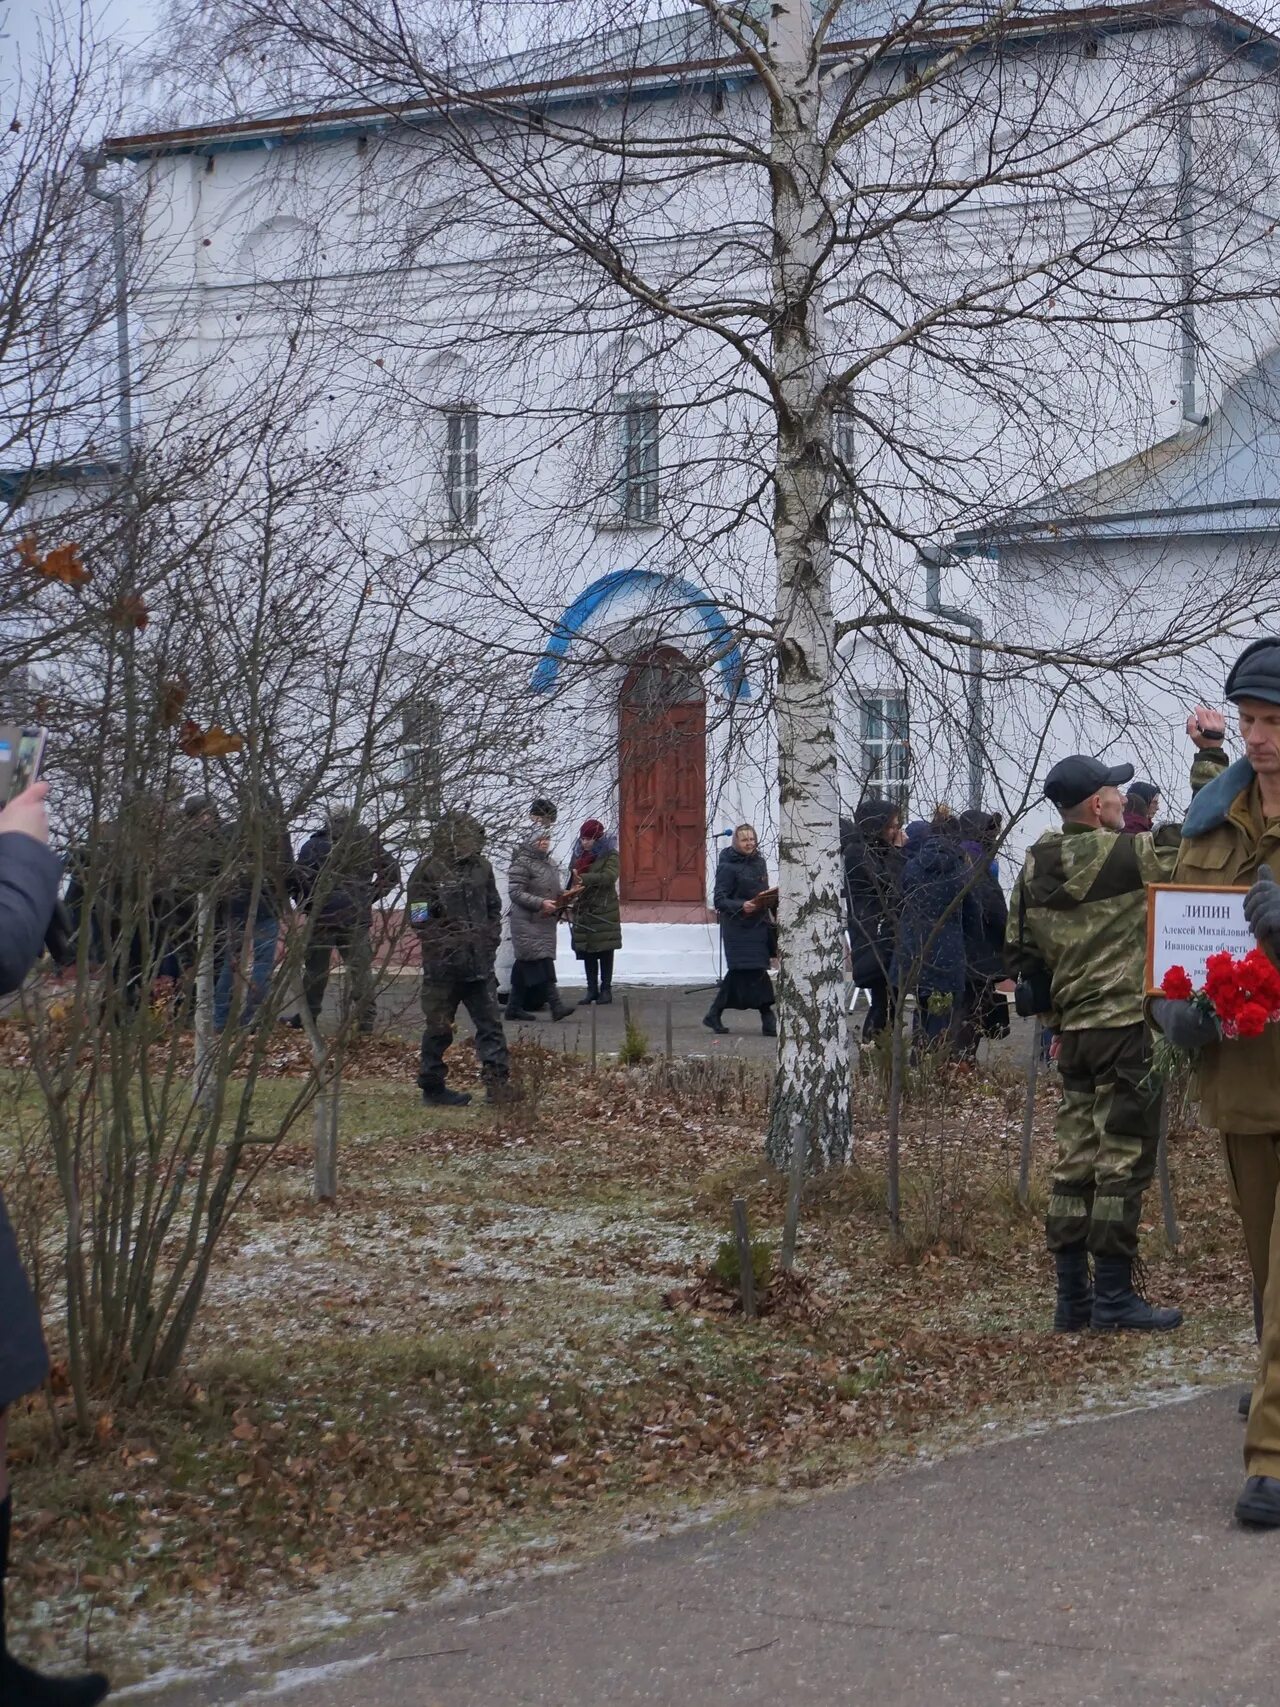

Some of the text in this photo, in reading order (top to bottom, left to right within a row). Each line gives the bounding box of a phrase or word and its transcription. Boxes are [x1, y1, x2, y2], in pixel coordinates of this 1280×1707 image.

[1182, 905, 1230, 919] ЛИПИН
[1162, 925, 1251, 937] Алексей Михайлович
[1164, 940, 1213, 951] Ивановская
